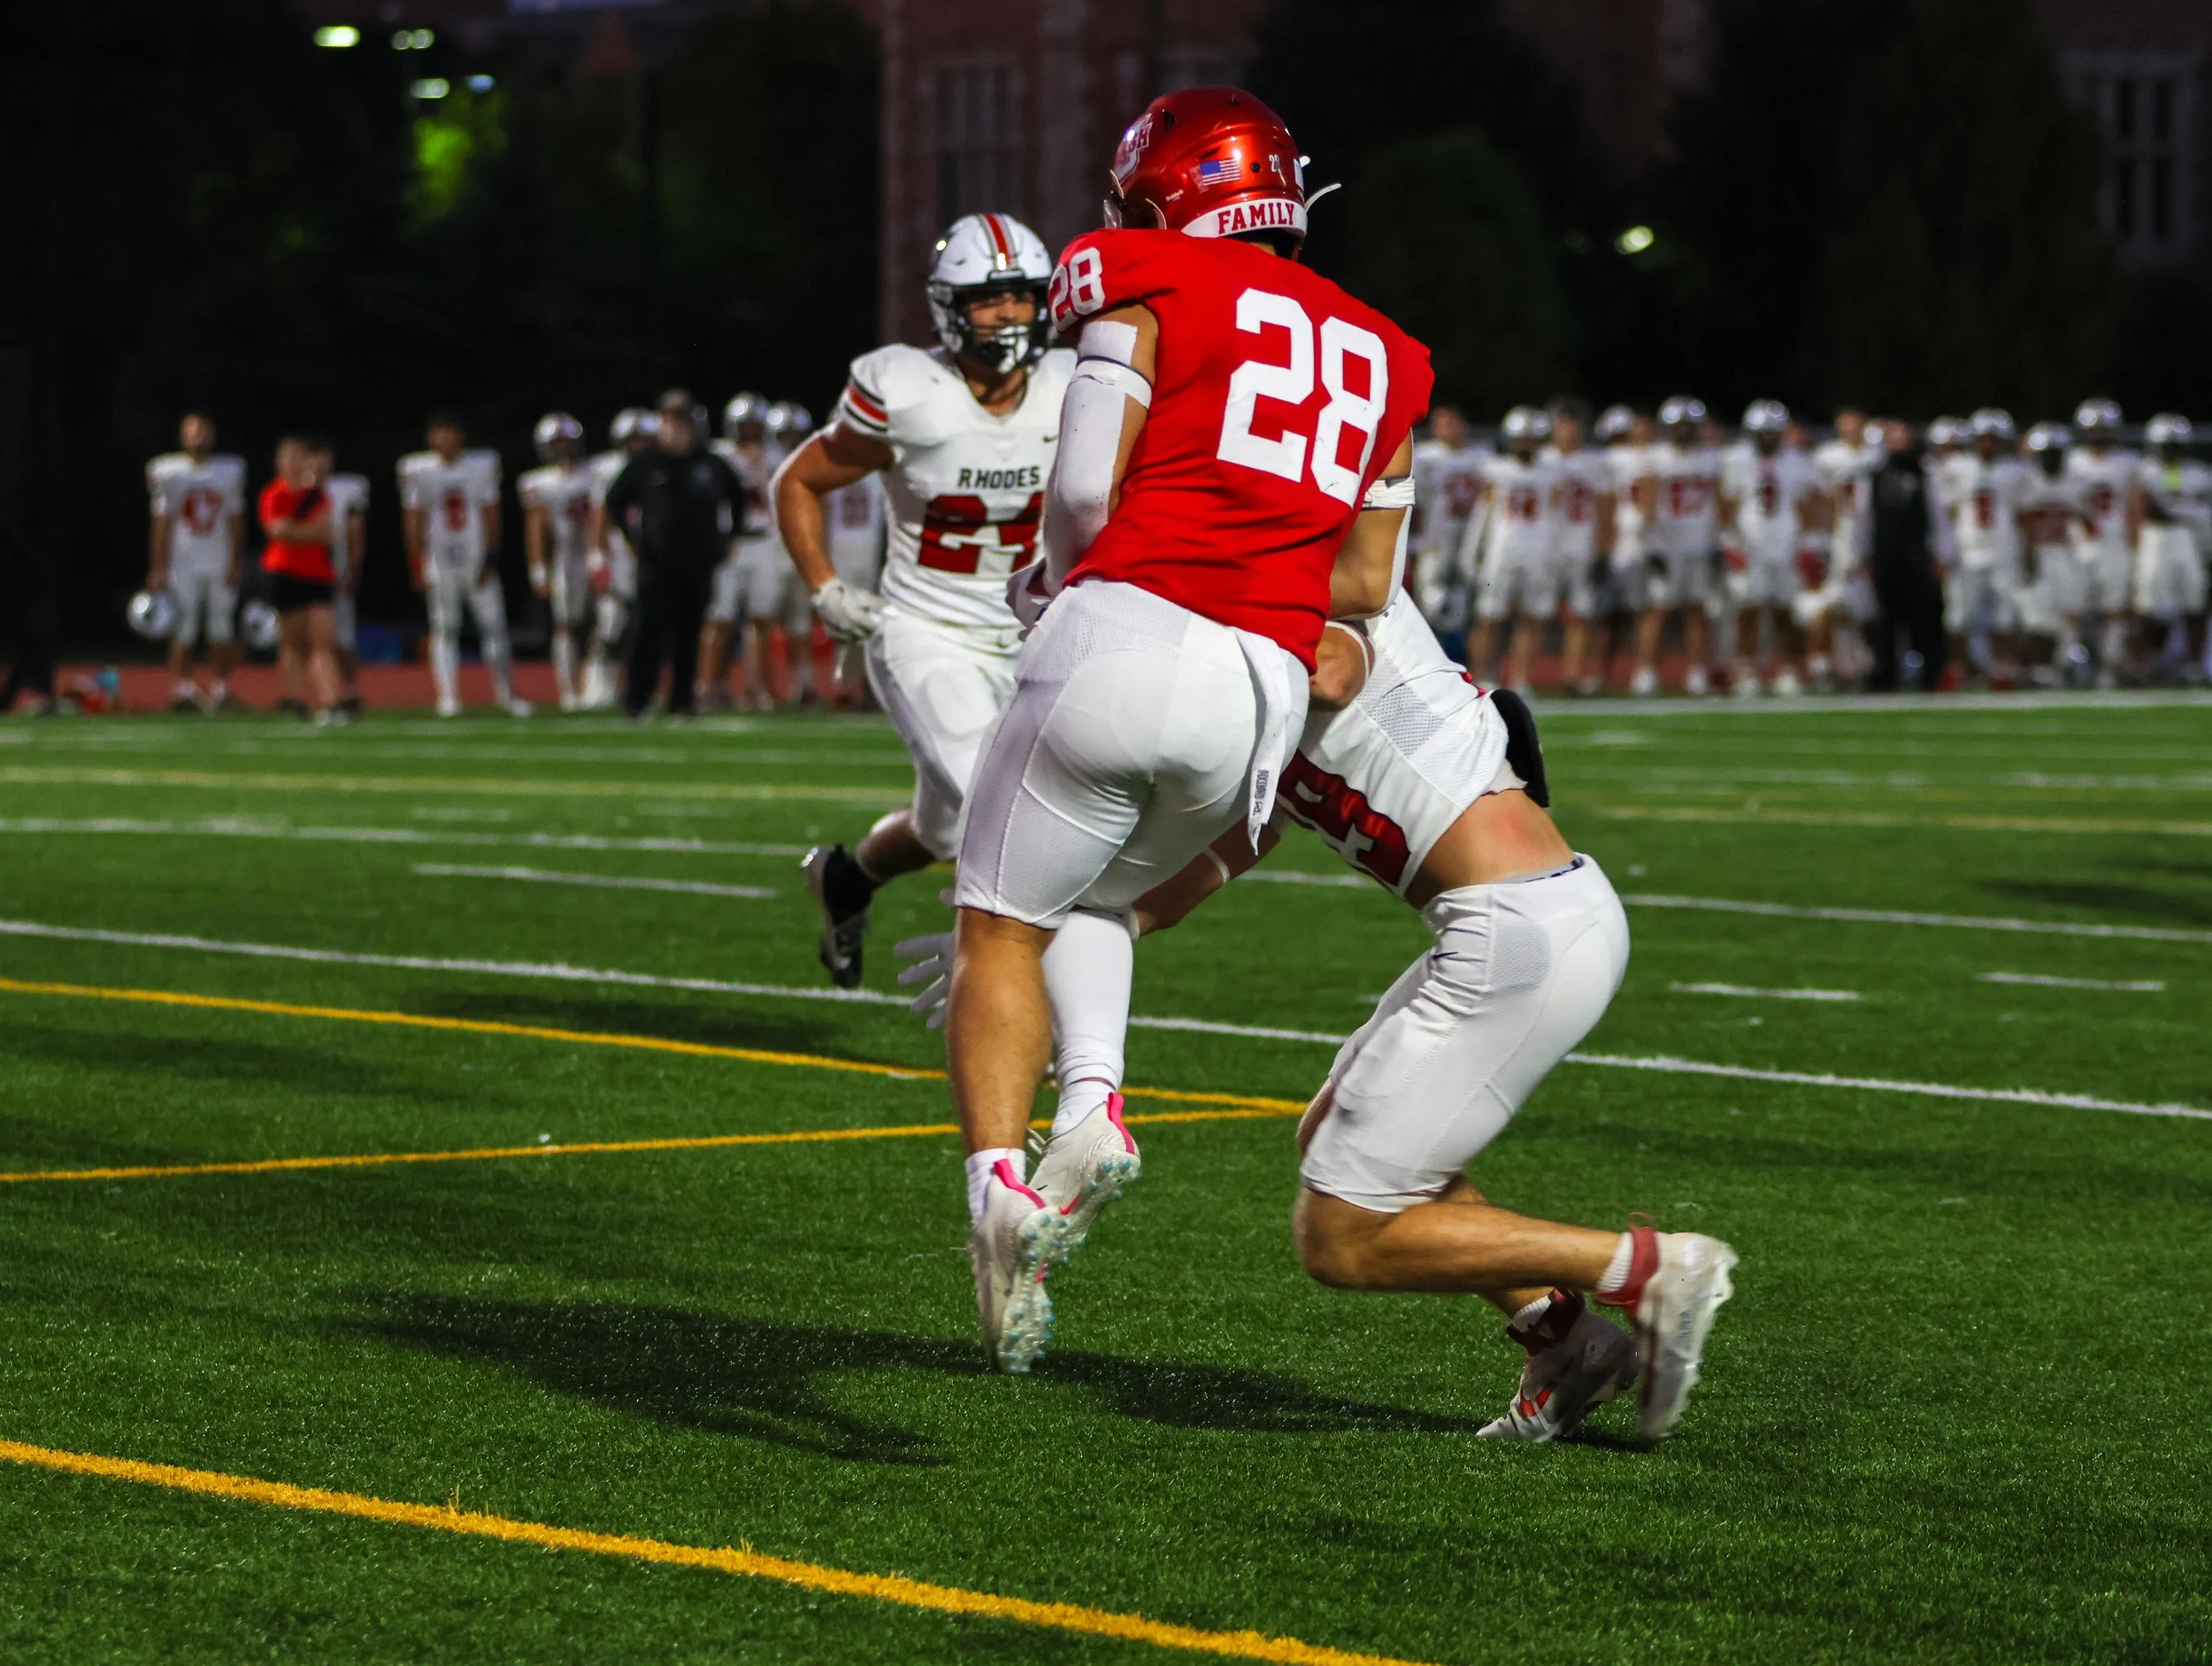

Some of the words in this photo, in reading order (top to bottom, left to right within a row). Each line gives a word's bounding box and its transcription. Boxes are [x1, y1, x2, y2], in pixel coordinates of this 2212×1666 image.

[1217, 202, 1295, 235] FAMILY
[1048, 246, 1105, 332] 28
[1216, 287, 1389, 511] 28
[957, 465, 1041, 488] RHODES
